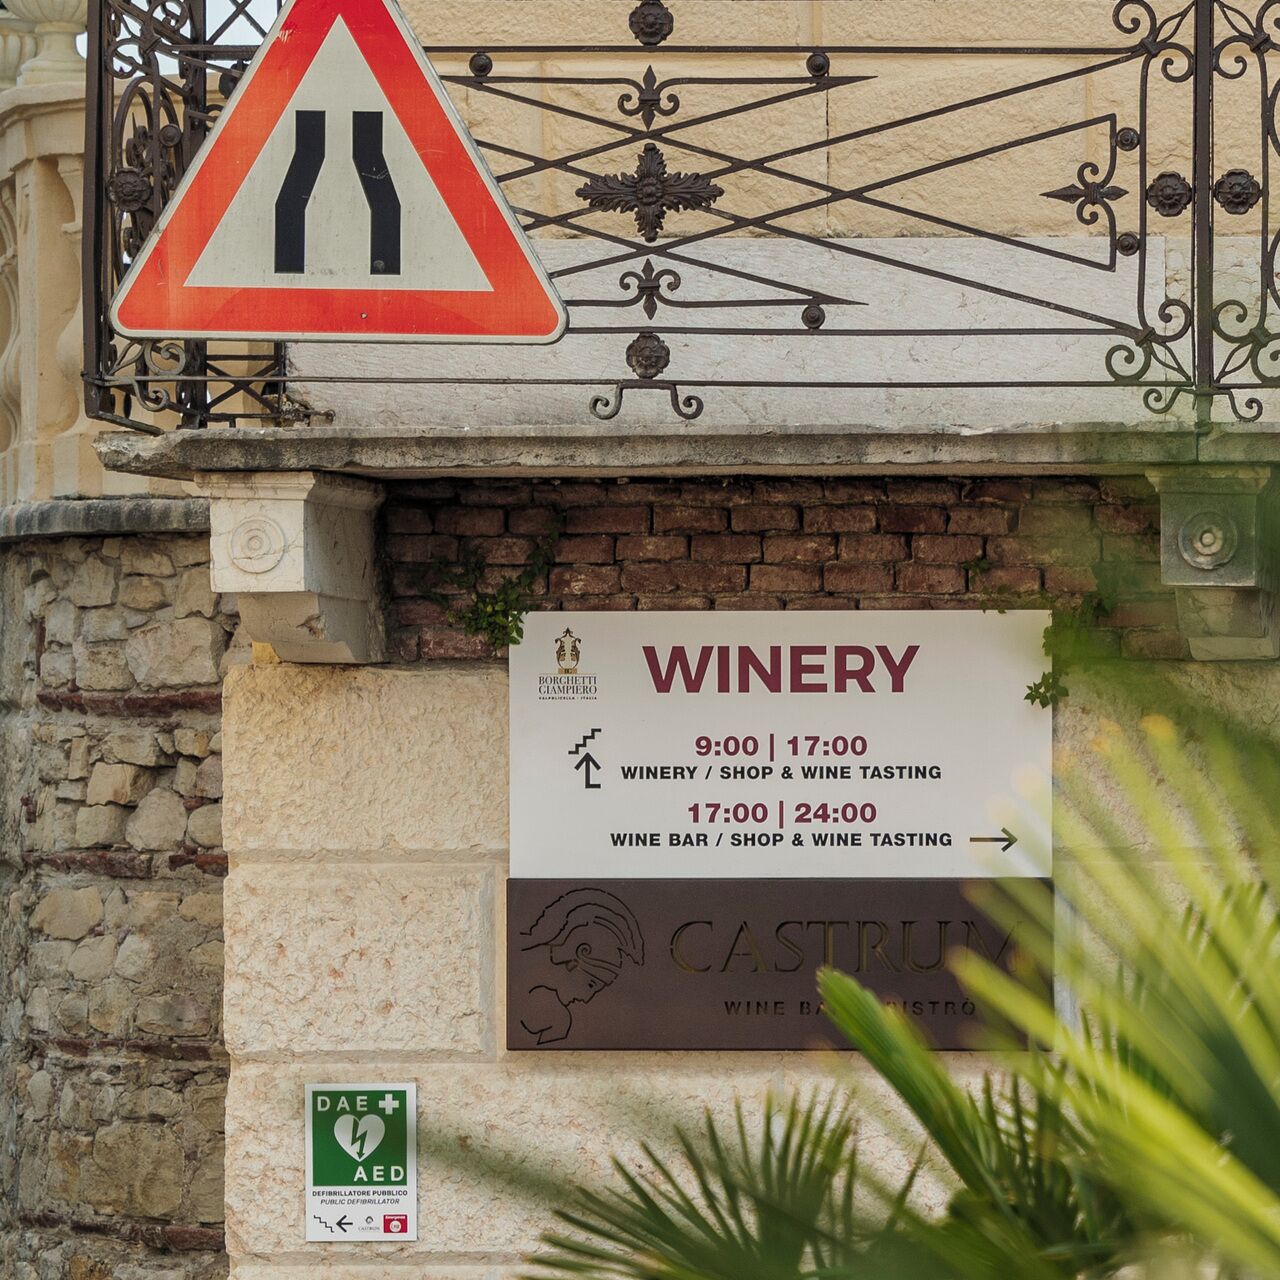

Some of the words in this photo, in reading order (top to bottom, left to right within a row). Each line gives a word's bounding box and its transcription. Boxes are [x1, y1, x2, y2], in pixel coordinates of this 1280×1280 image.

[641, 644, 921, 694] WINERY
[539, 676, 597, 685] BORGHETTI
[538, 685, 598, 695] GIAMPIERO
[694, 735, 759, 757] 9:00
[786, 735, 868, 757] 17:00
[620, 765, 699, 781] WINERY
[704, 765, 713, 781] /
[719, 765, 774, 781] SHOP
[780, 765, 794, 781] &
[800, 765, 852, 781] WINE
[858, 765, 942, 781] TASTING
[687, 802, 769, 824] 17:00
[794, 802, 877, 824] 24:00
[609, 832, 661, 848] WINE
[668, 832, 709, 848] BAR
[715, 832, 724, 848] /
[729, 832, 785, 848] SHOP
[791, 832, 805, 848] &
[810, 832, 863, 848] WINE
[869, 832, 953, 848] TASTING
[669, 920, 1025, 973] CASTRUM
[724, 1000, 786, 1016] WINE
[316, 1096, 368, 1112] DAE
[353, 1165, 405, 1182] AED
[320, 1198, 346, 1206] PUBLIC
[347, 1198, 400, 1206] DEFIBRILLATOR
